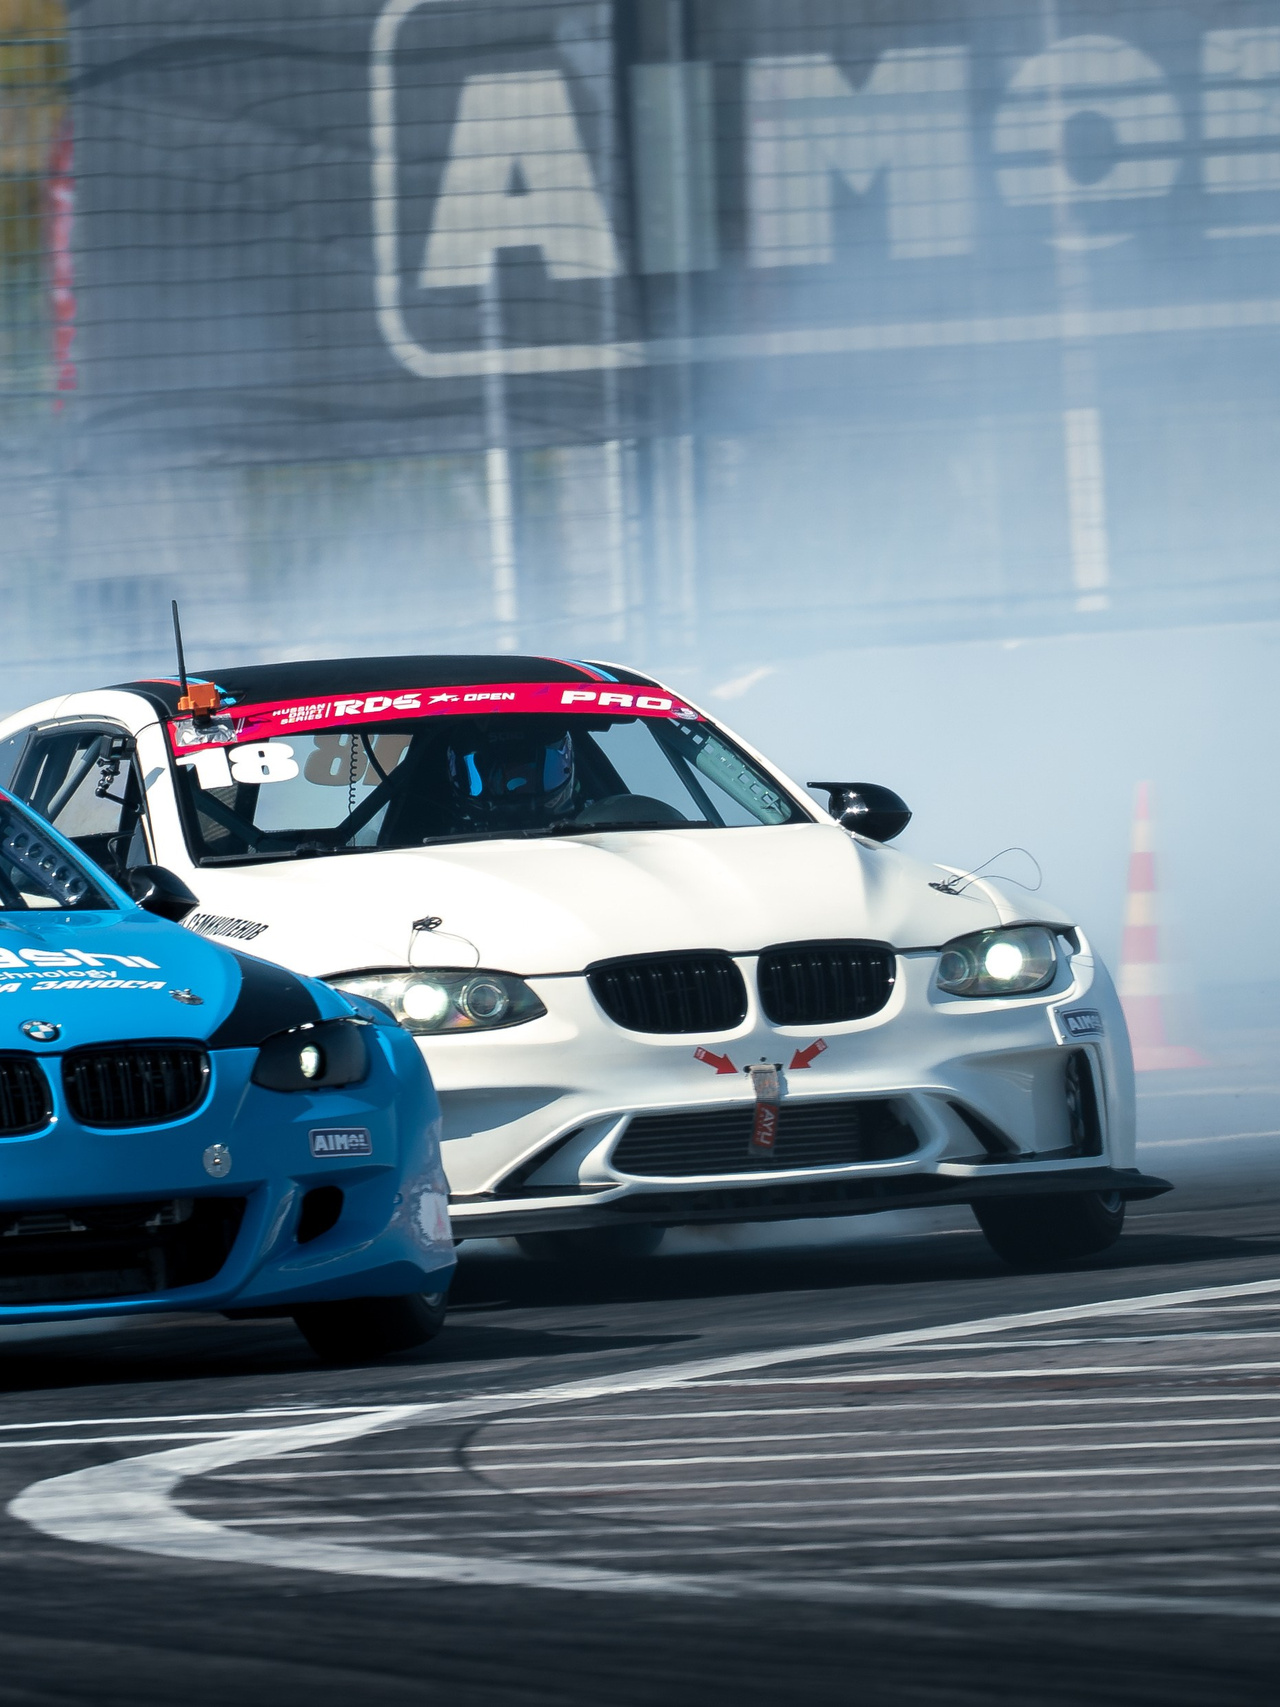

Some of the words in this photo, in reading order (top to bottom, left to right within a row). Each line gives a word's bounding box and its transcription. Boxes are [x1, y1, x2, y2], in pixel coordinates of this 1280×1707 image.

[333, 693, 422, 717] RDS
[463, 692, 516, 702] OPEN
[561, 690, 673, 710] PRO
[280, 714, 323, 725] SERIES
[288, 709, 324, 719] DRIFT
[175, 743, 300, 790] 18
[31, 979, 167, 991] ЗАНОСА
[314, 1134, 369, 1151] AIMOL
